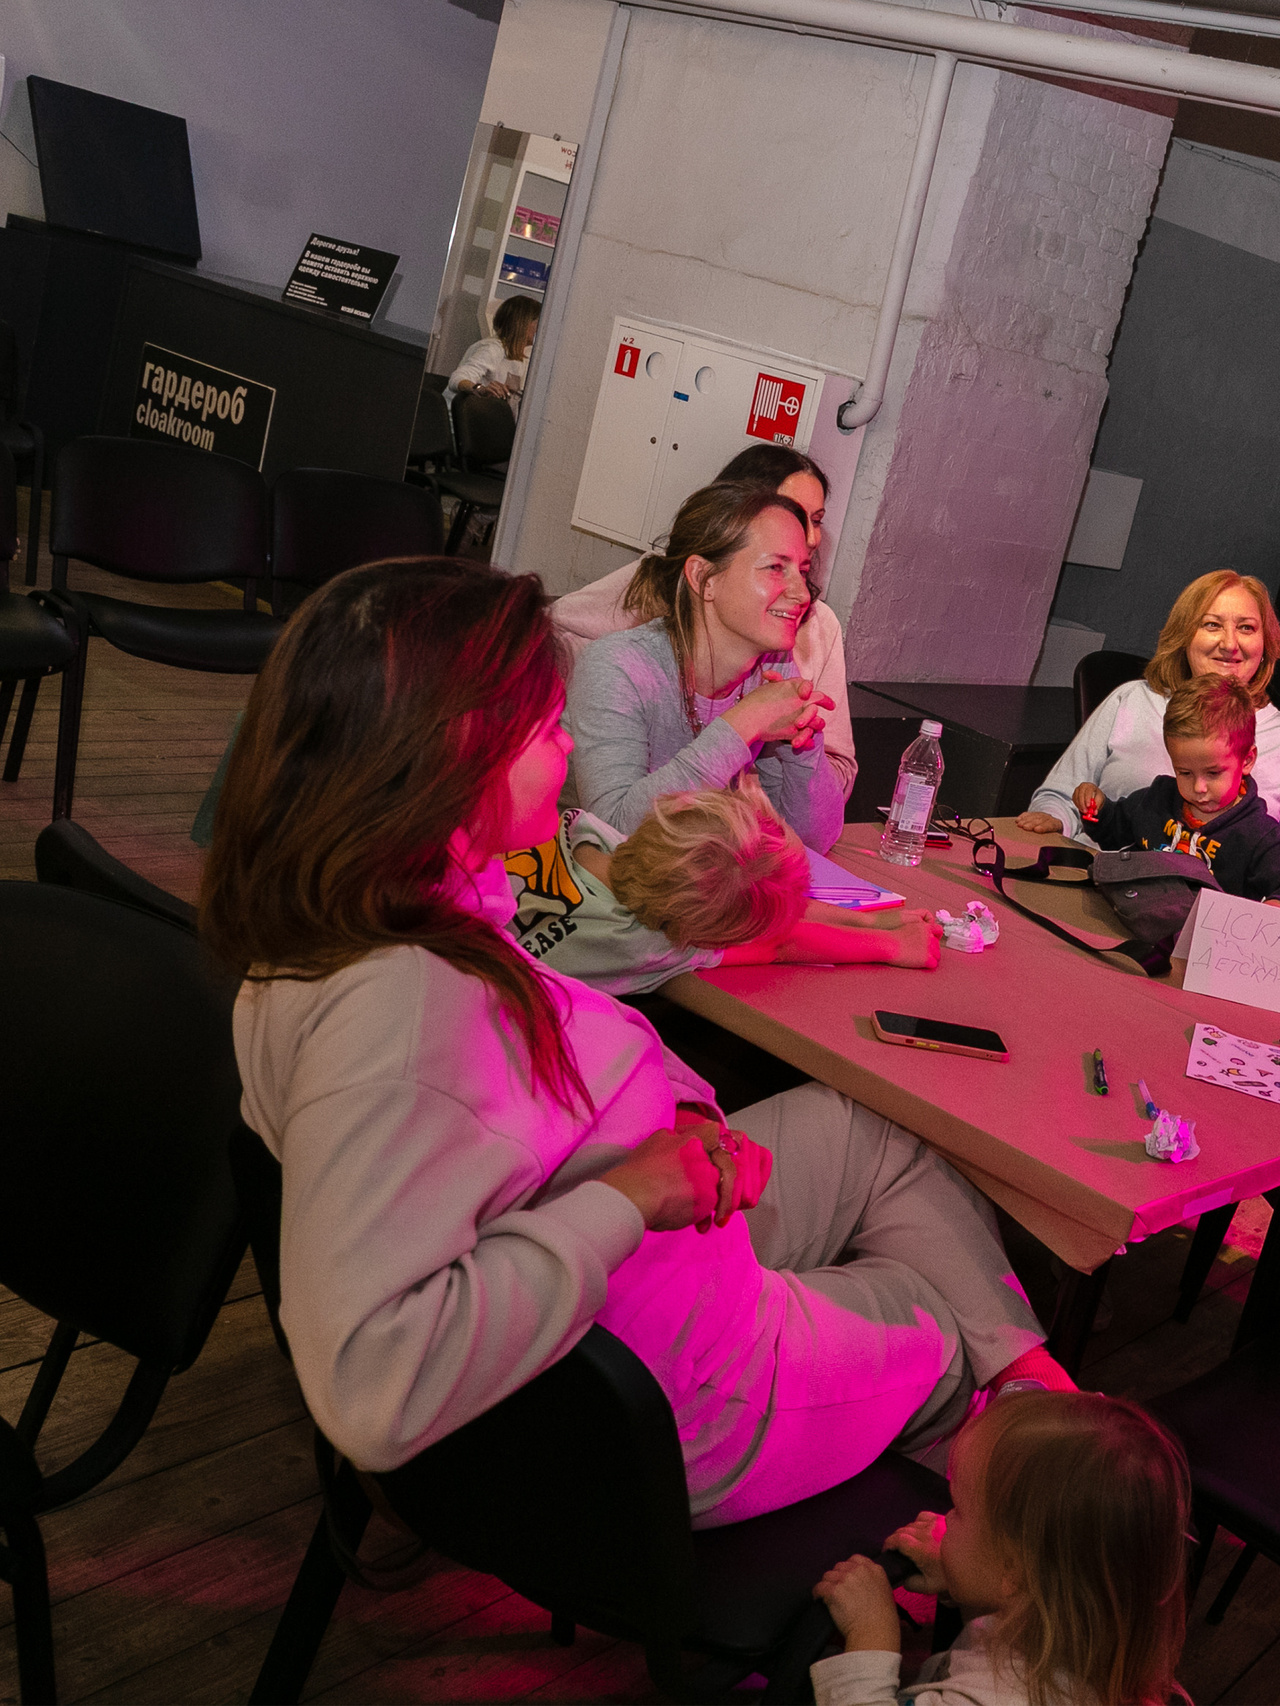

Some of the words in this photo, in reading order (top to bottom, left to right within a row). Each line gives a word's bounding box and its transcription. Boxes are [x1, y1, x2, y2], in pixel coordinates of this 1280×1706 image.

[310, 237, 336, 250] Дорогие
[336, 245, 360, 256] друзья!
[298, 265, 321, 277] одежду
[301, 259, 324, 270] можете
[324, 264, 350, 277] оставить
[351, 271, 379, 285] верхнюю
[304, 250, 311, 258] В
[310, 253, 331, 264] нашем
[330, 258, 361, 272] гардеробе
[361, 266, 371, 275] вы
[142, 361, 248, 425] гардероб
[136, 398, 215, 452] cloakroom
